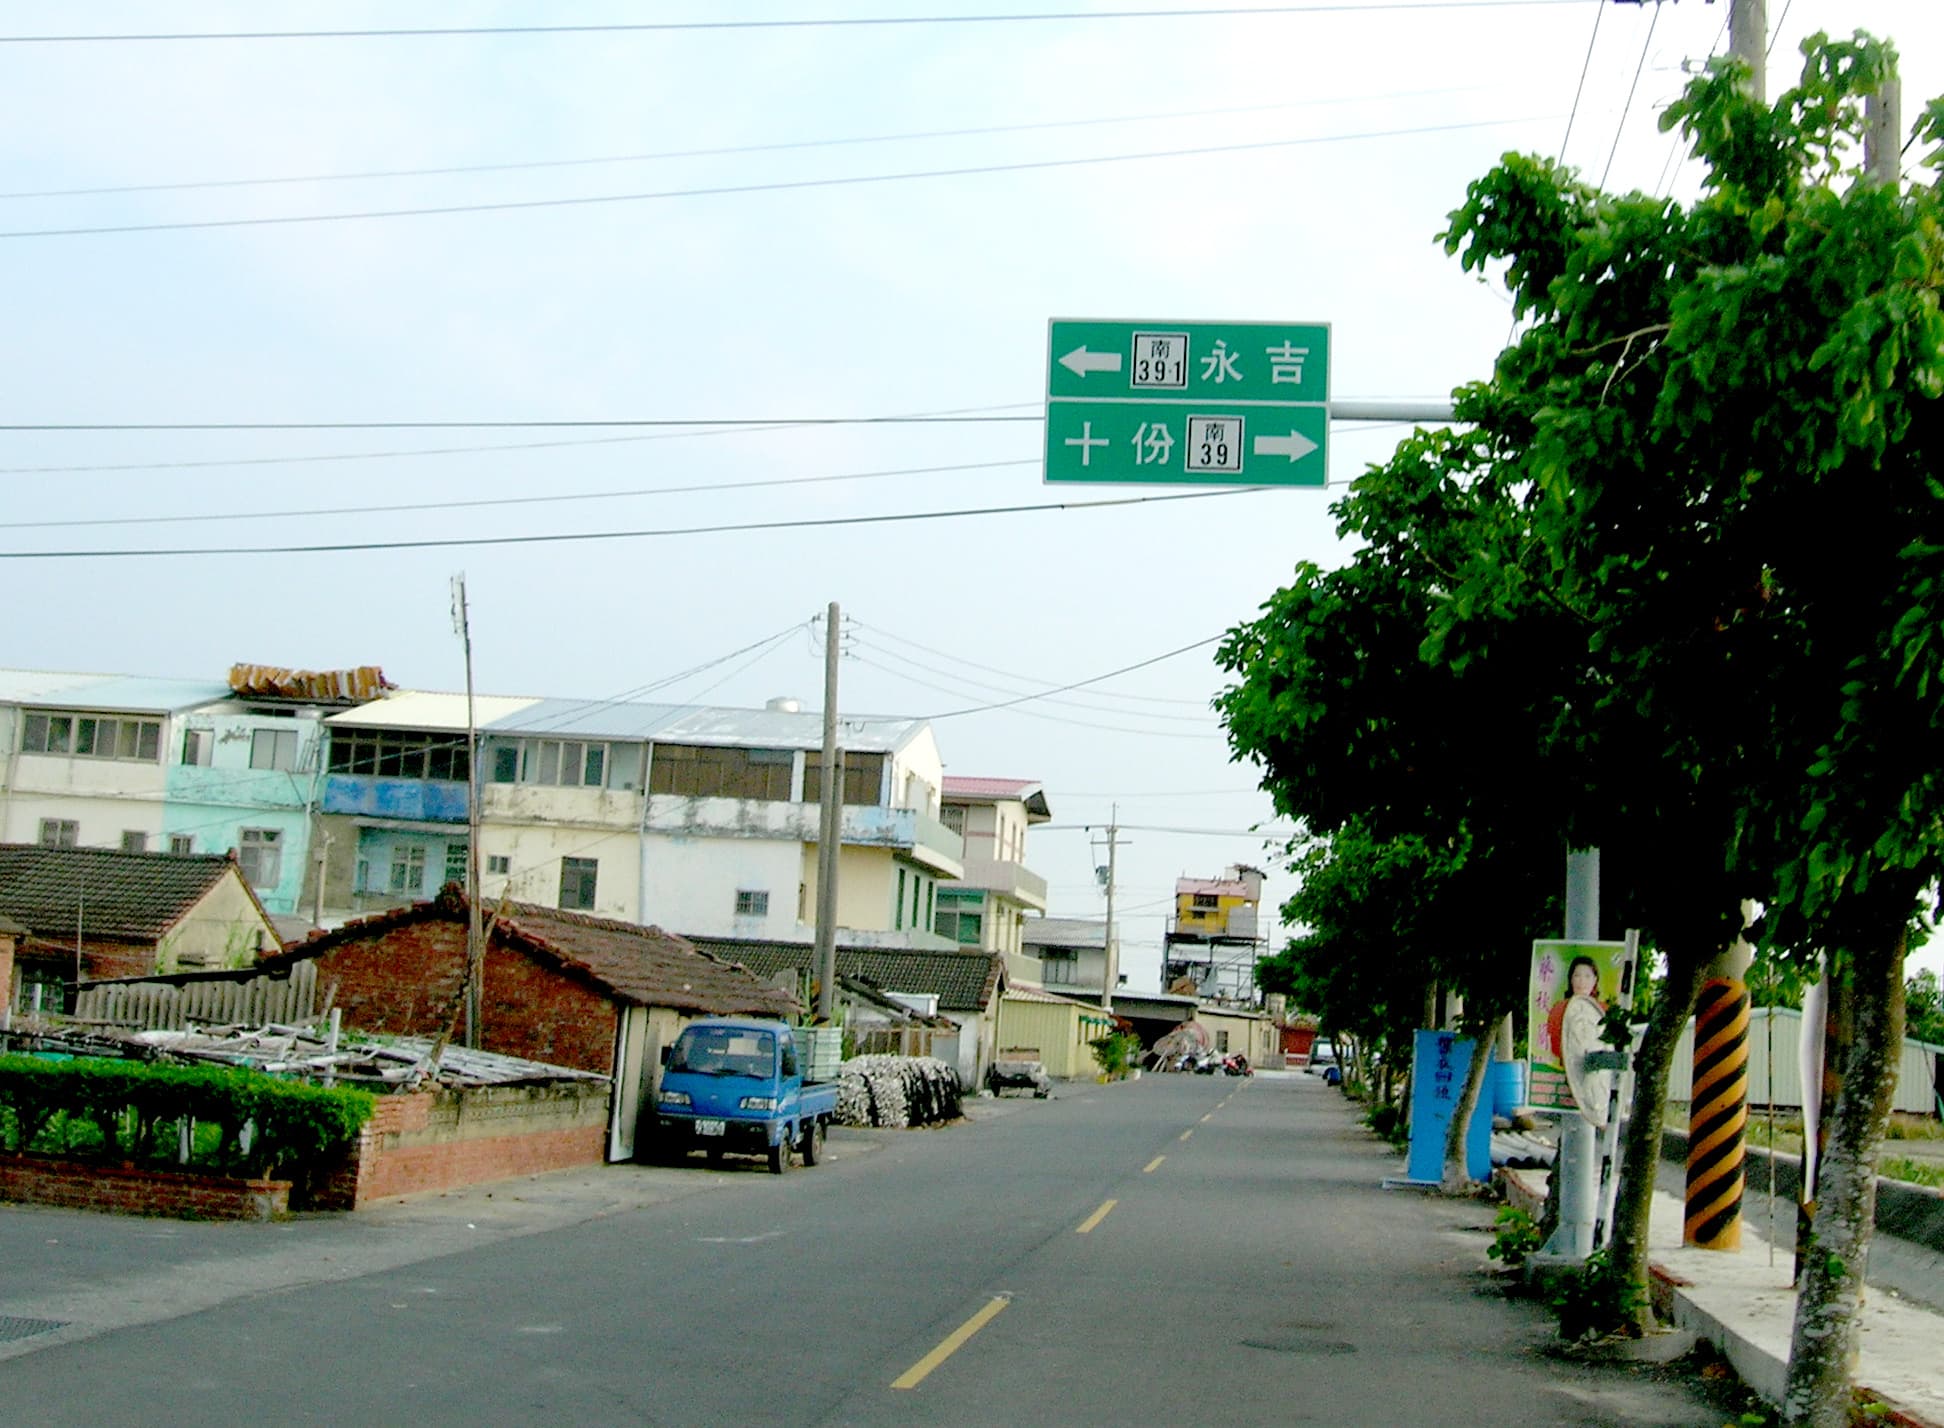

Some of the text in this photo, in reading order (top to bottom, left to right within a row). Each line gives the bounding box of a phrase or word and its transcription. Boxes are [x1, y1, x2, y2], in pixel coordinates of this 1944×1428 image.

[1151, 339, 1170, 359] 南
[1200, 339, 1310, 385] 永吉
[1205, 422, 1225, 442] 南
[1064, 421, 1175, 466] 十份
[1200, 443, 1229, 465] 39
